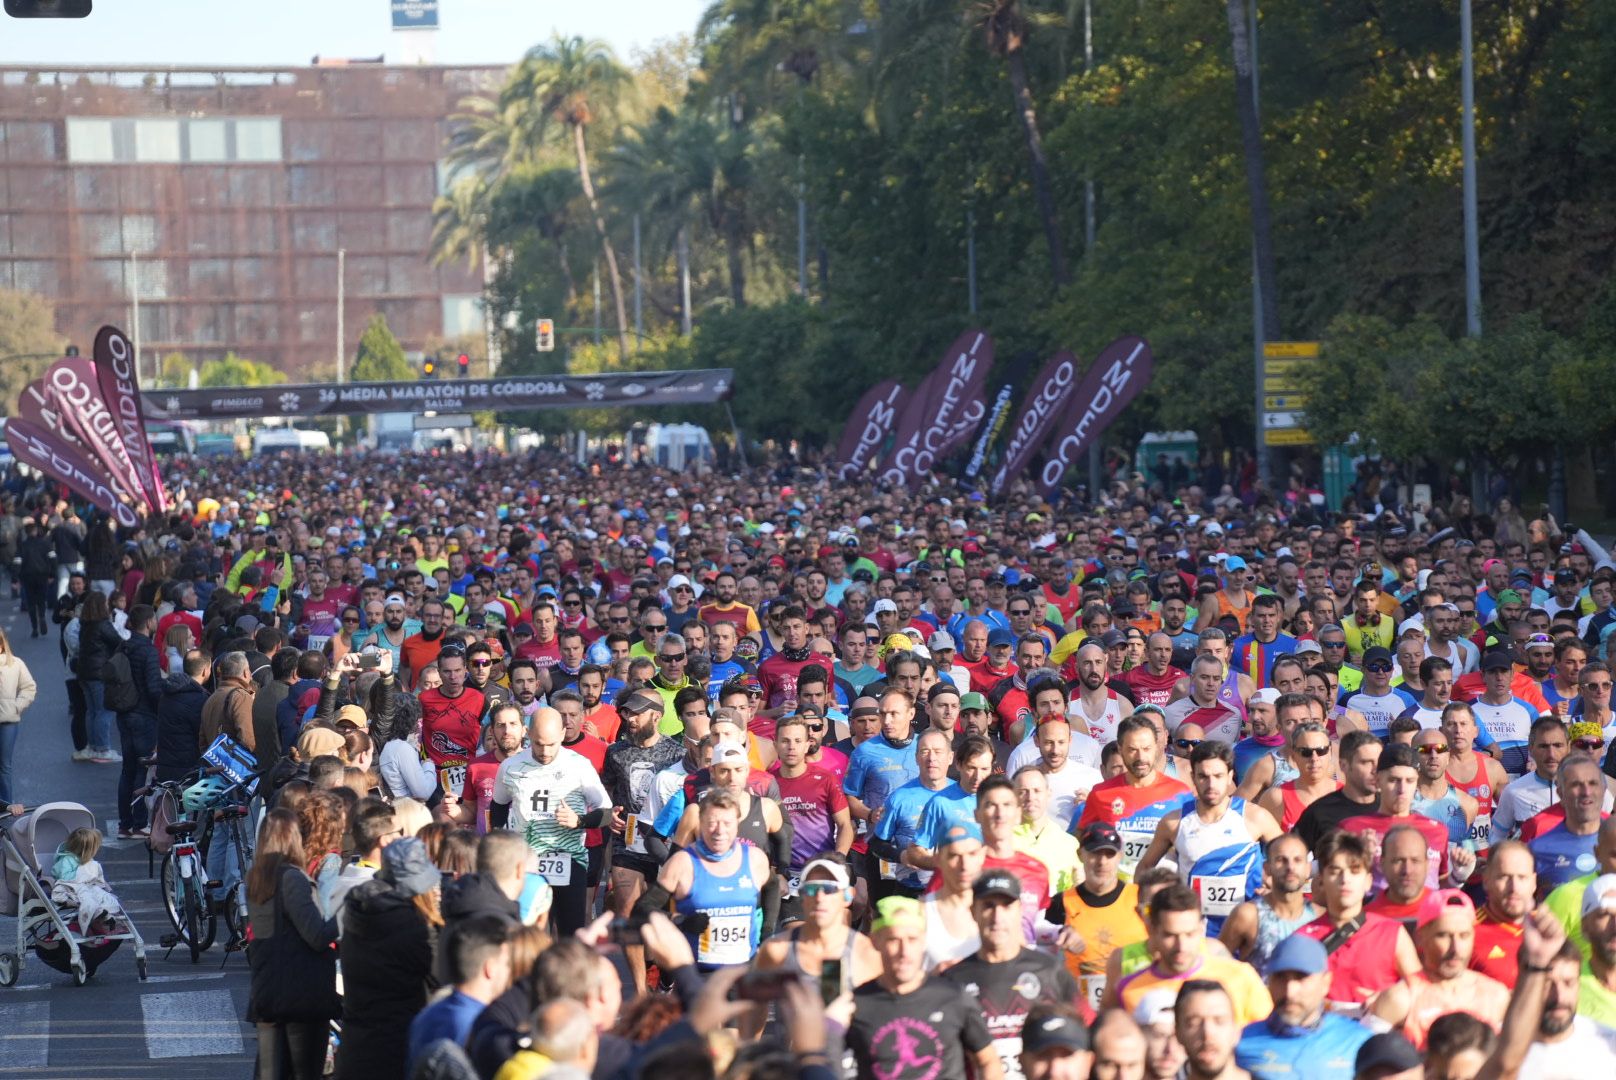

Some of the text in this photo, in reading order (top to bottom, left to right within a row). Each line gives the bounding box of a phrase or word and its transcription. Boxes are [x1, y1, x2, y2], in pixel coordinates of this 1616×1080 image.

[108, 334, 142, 456] IMDECO
[319, 380, 567, 402] 36 MEDIA MARATÓN DE CÓRDOBA
[424, 399, 462, 408] SALIDA
[1042, 341, 1145, 487] IMDECO
[530, 789, 549, 812] fi
[538, 860, 564, 874] 578
[1207, 886, 1237, 902] 327
[711, 927, 747, 943] 1954
